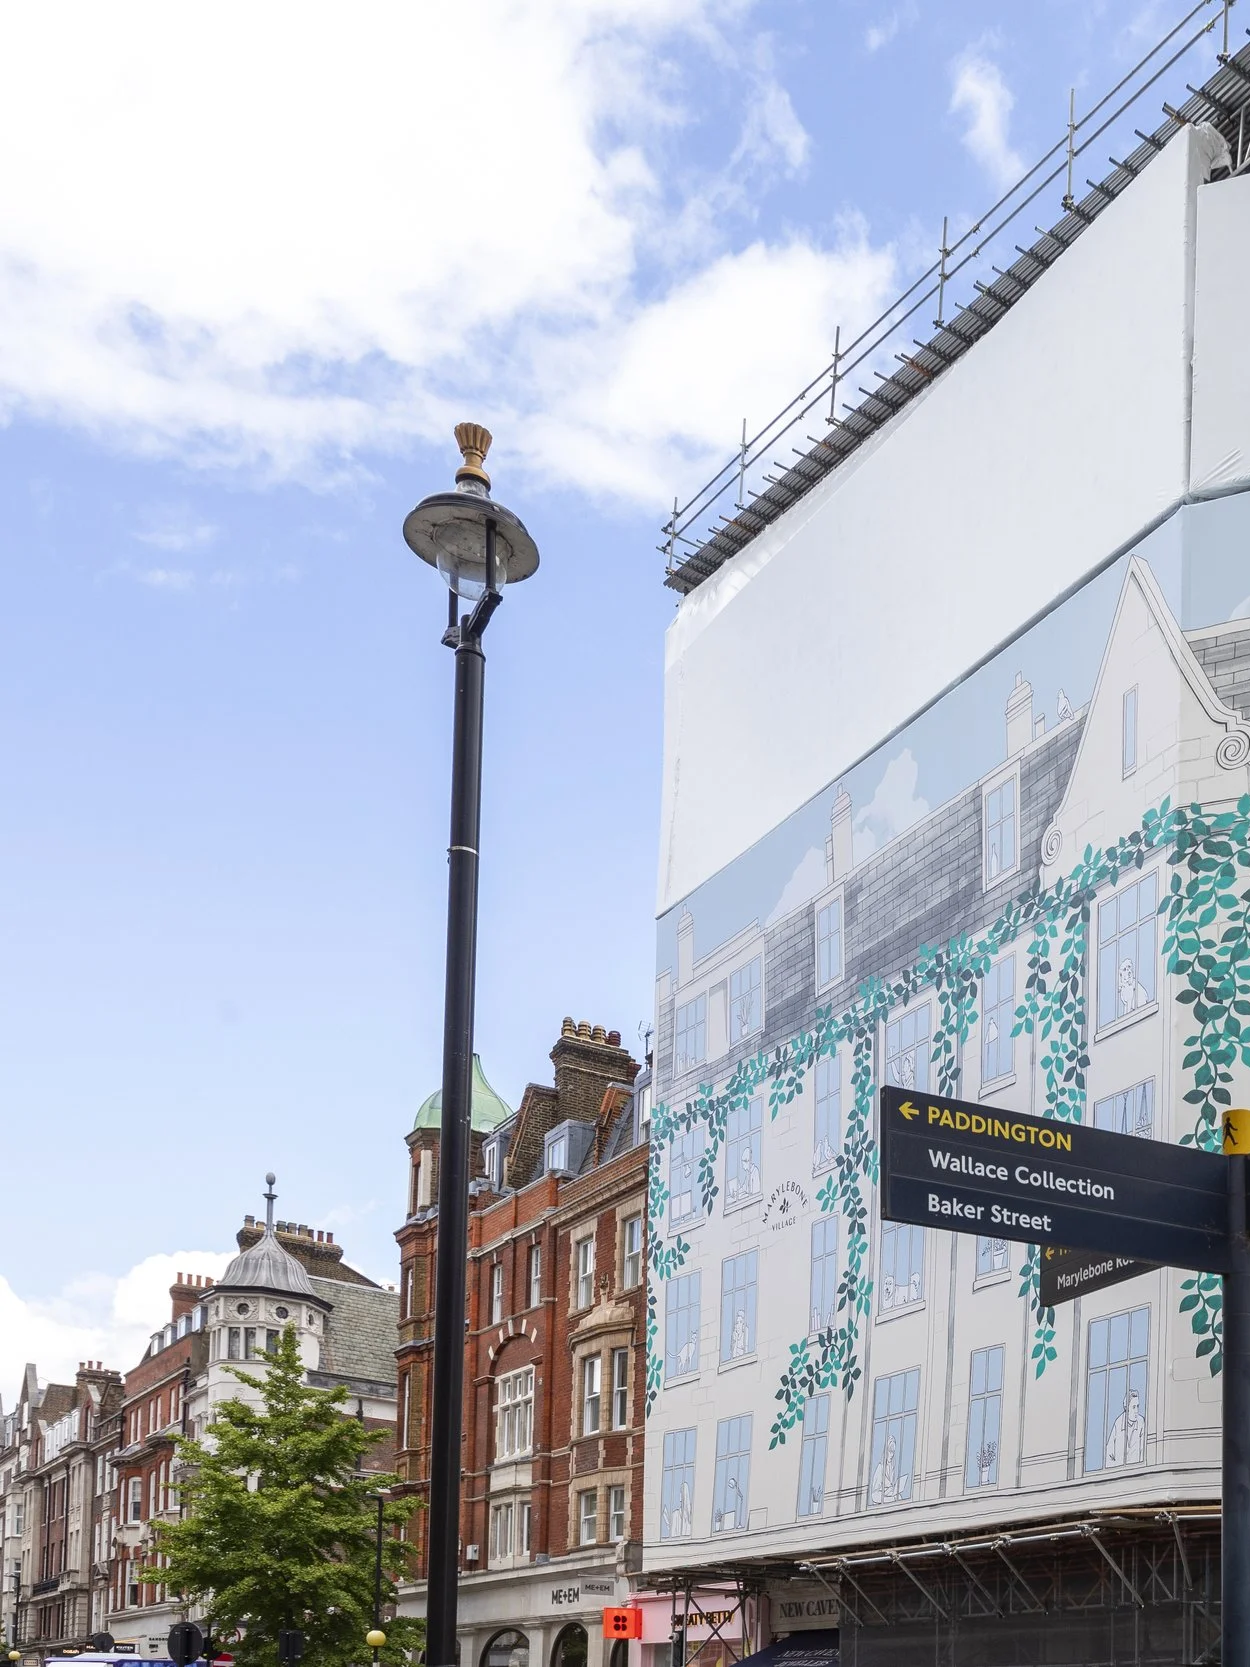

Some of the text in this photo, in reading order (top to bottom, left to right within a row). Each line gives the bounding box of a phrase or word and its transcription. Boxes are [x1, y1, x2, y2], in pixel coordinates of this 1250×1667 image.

[928, 1106, 1072, 1152] PADDINGTON
[928, 1149, 1115, 1200] Wallace Collection
[928, 1193, 1052, 1232] Baker Street
[1057, 1257, 1135, 1290] Marylebone Ro
[551, 1587, 580, 1605] ME+EM
[585, 1584, 610, 1592] ME+EM
